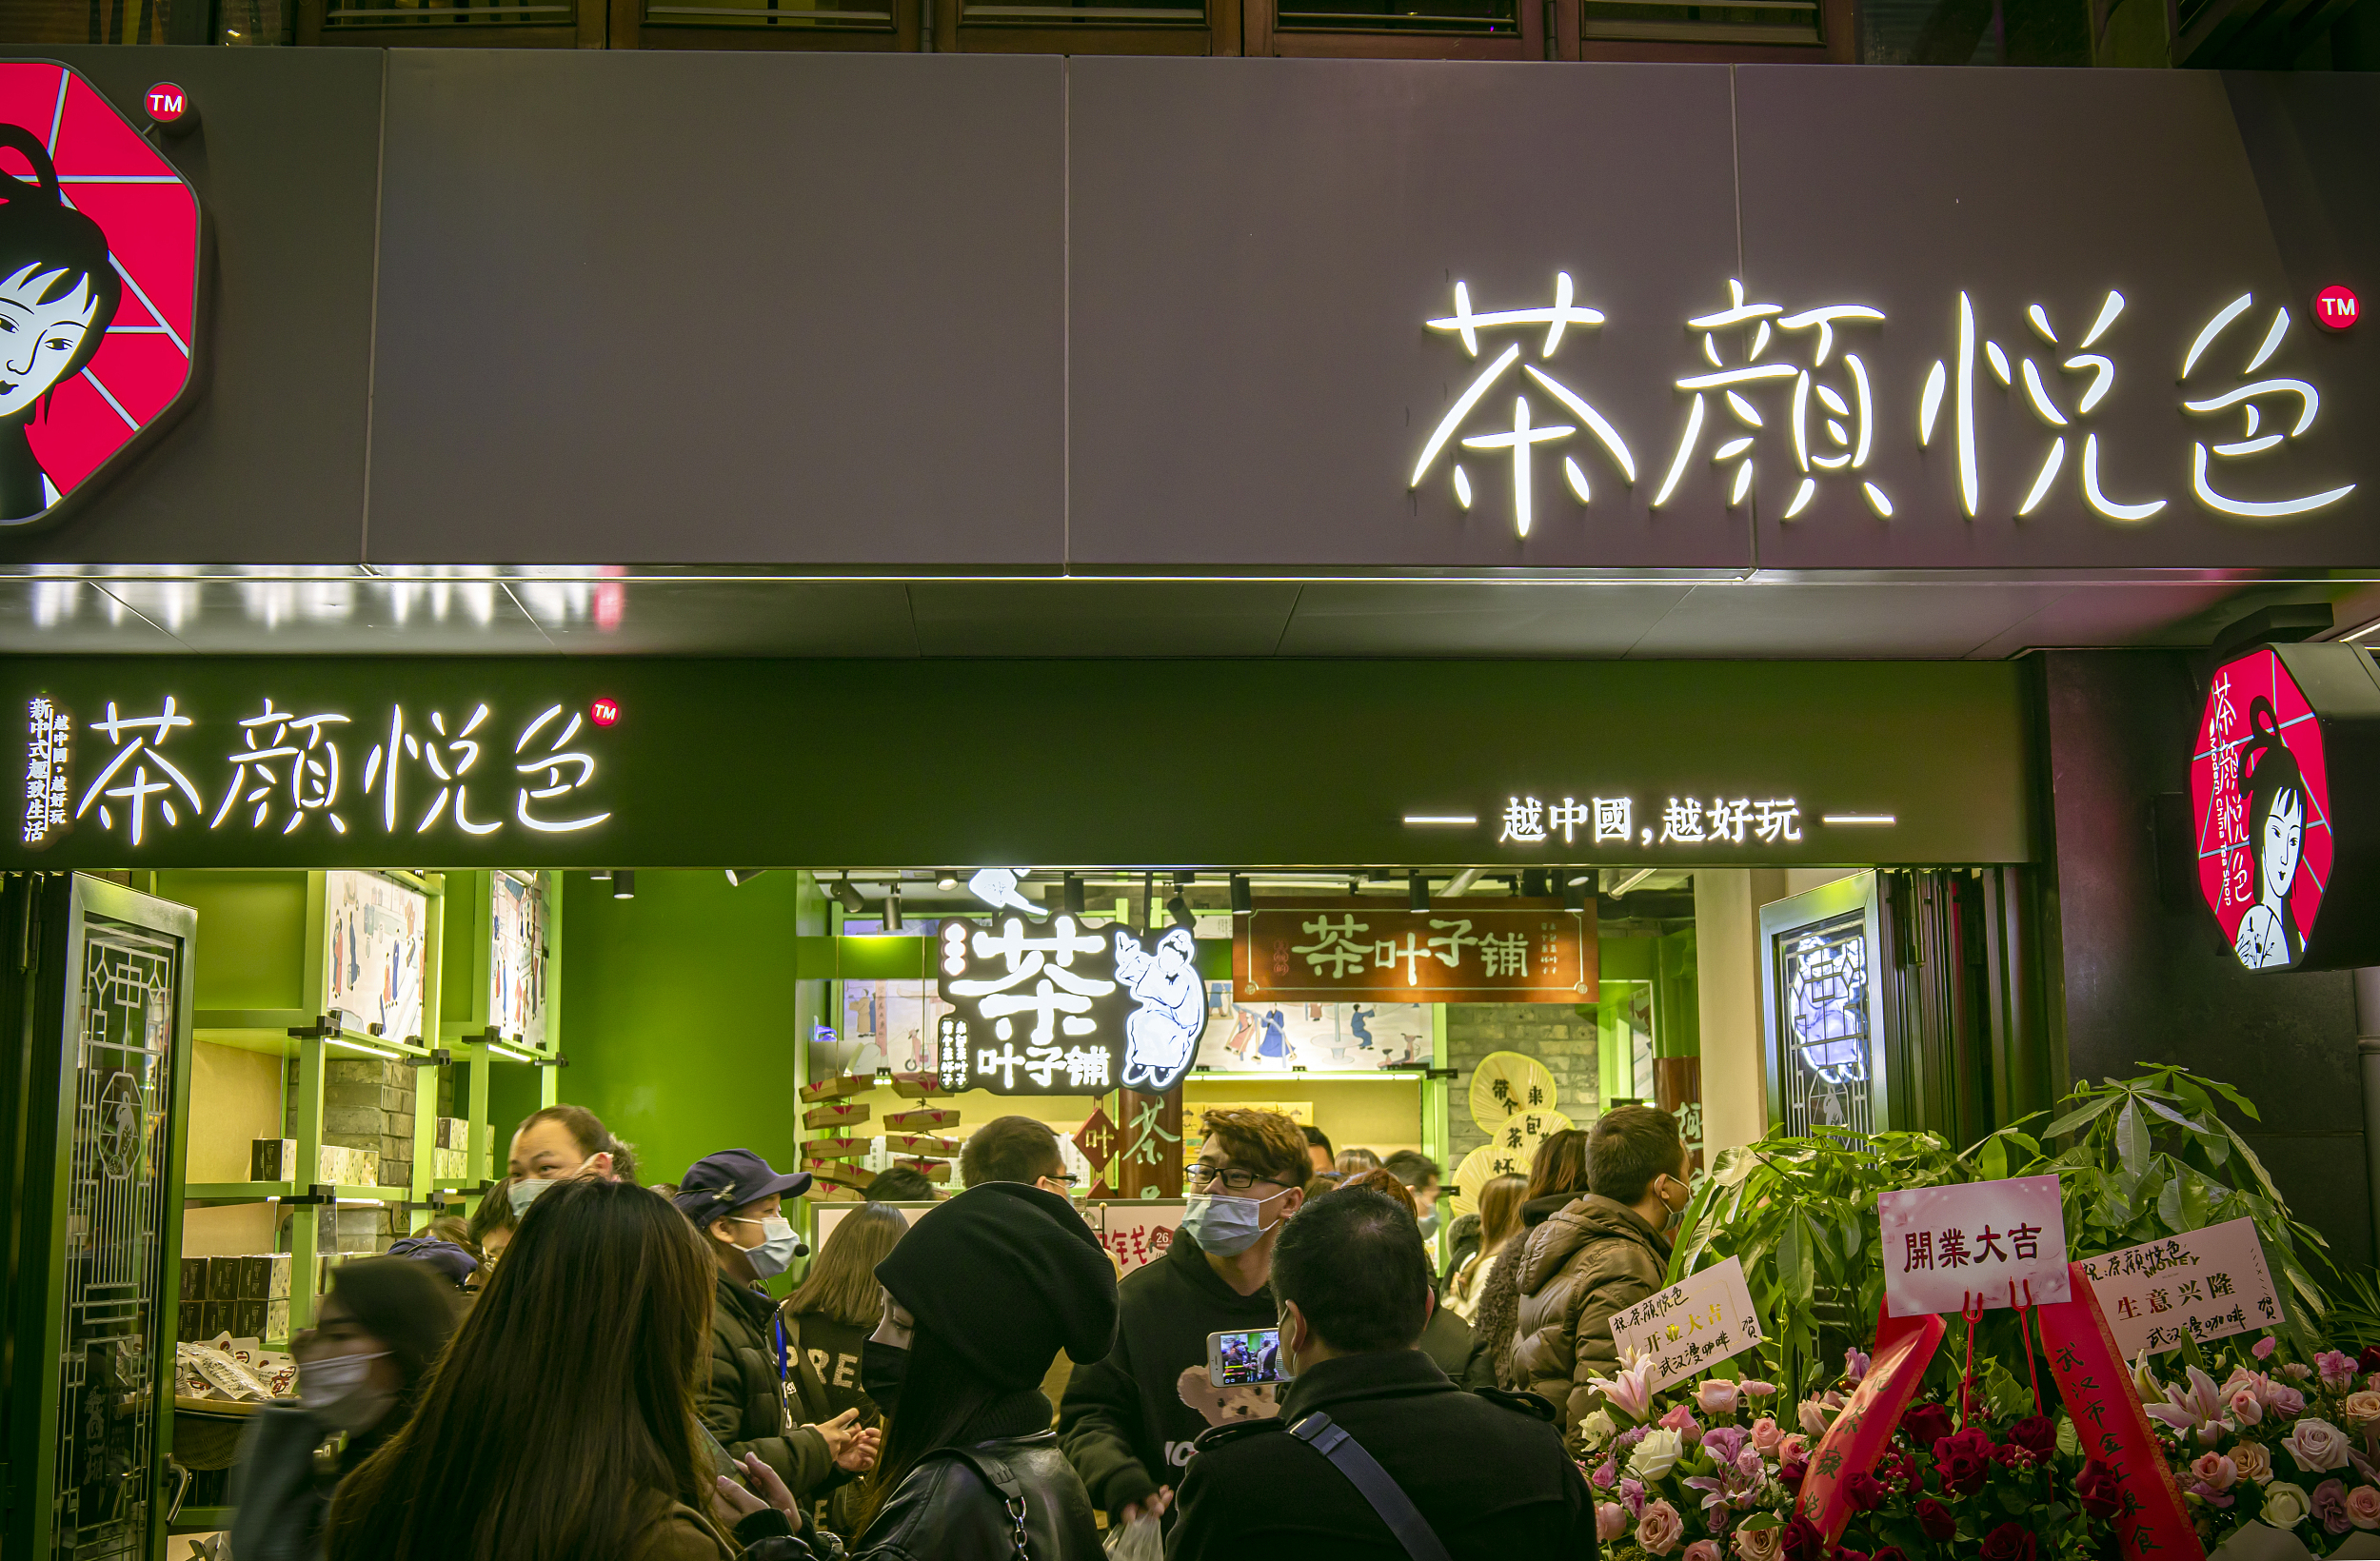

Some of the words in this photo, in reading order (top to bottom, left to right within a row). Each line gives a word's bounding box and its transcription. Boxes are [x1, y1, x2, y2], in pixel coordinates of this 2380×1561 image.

[149, 94, 182, 112] TM
[2321, 298, 2356, 318] TM
[594, 704, 617, 721] TM
[2210, 738, 2220, 795] Modern
[2215, 798, 2226, 839] China
[2223, 870, 2231, 906] Shop
[1291, 914, 1529, 986] 茶叶子铺
[949, 916, 1116, 1046] 茶
[977, 1043, 1111, 1089] 叶子铺
[1085, 1124, 1115, 1159] 叶
[1156, 1232, 1169, 1243] 26
[1904, 1222, 2042, 1274] 開業大吉
[2143, 1255, 2201, 1279] MONEY
[2117, 1272, 2236, 1321] 生意兴隆
[1644, 1303, 1722, 1354] 开业大吉
